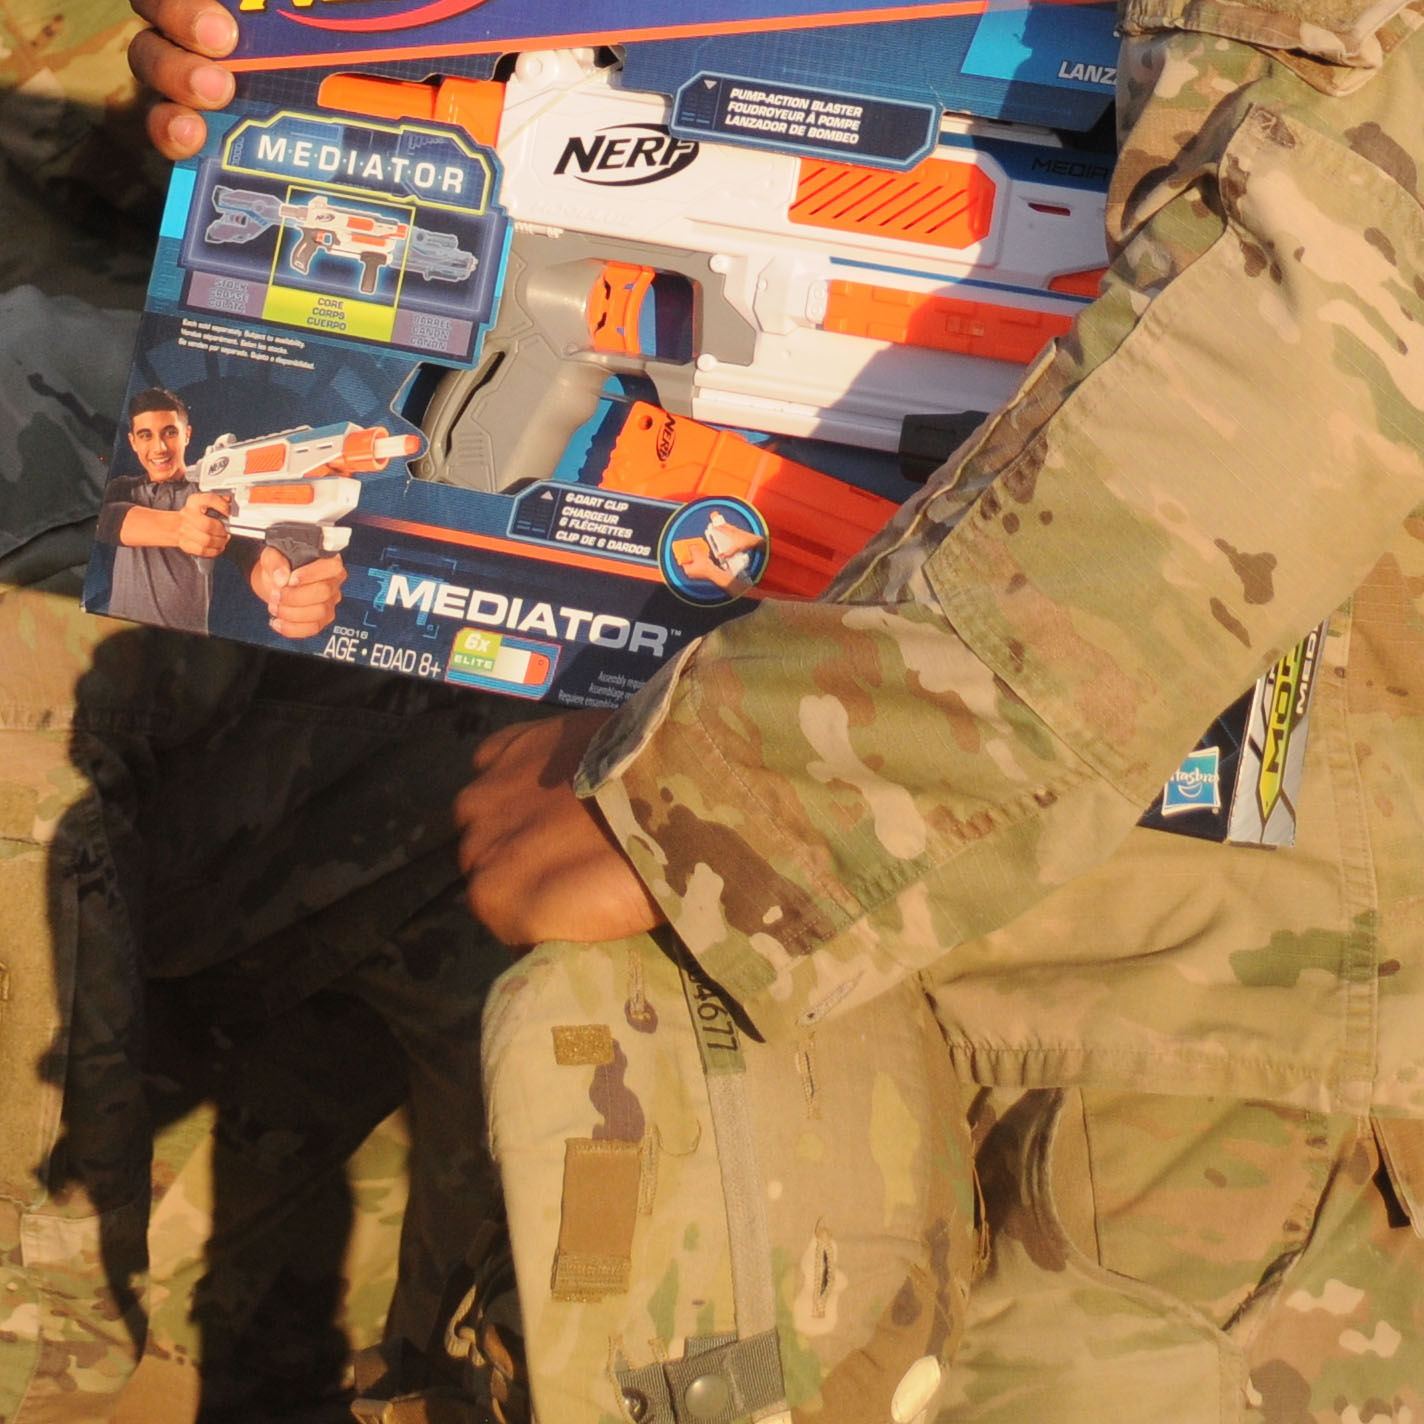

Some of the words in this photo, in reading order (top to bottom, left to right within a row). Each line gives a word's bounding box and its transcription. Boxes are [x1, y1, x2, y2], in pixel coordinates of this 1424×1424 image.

[729, 87, 811, 110] PUMP-ACTION
[810, 100, 864, 118] BLASTER
[727, 101, 808, 124] FOUDROYEUR
[805, 111, 817, 125] À
[817, 114, 862, 132] POMPE
[725, 114, 788, 134] LANZADOR
[788, 123, 806, 136] DE
[806, 126, 860, 145] BOMBEO
[553, 135, 696, 175] NERF
[312, 307, 345, 320] CORPS
[317, 297, 344, 309] CORE
[306, 317, 347, 331] CUERPO
[565, 492, 604, 509] 6-DART
[603, 500, 630, 512] CLIP
[561, 506, 620, 525] CHARGEUR
[559, 517, 567, 527] 6
[568, 518, 634, 539] FLÉCHETTES
[555, 530, 580, 543] CLIP
[579, 535, 597, 547] DE
[596, 537, 607, 548] 6
[606, 539, 652, 556] DARDOS
[384, 573, 670, 659] MEDIATOR
[463, 631, 490, 654] 6x
[323, 634, 358, 663] AGE
[369, 642, 417, 674] EDAD
[417, 651, 442, 679] 8+
[452, 654, 495, 672] ELITE
